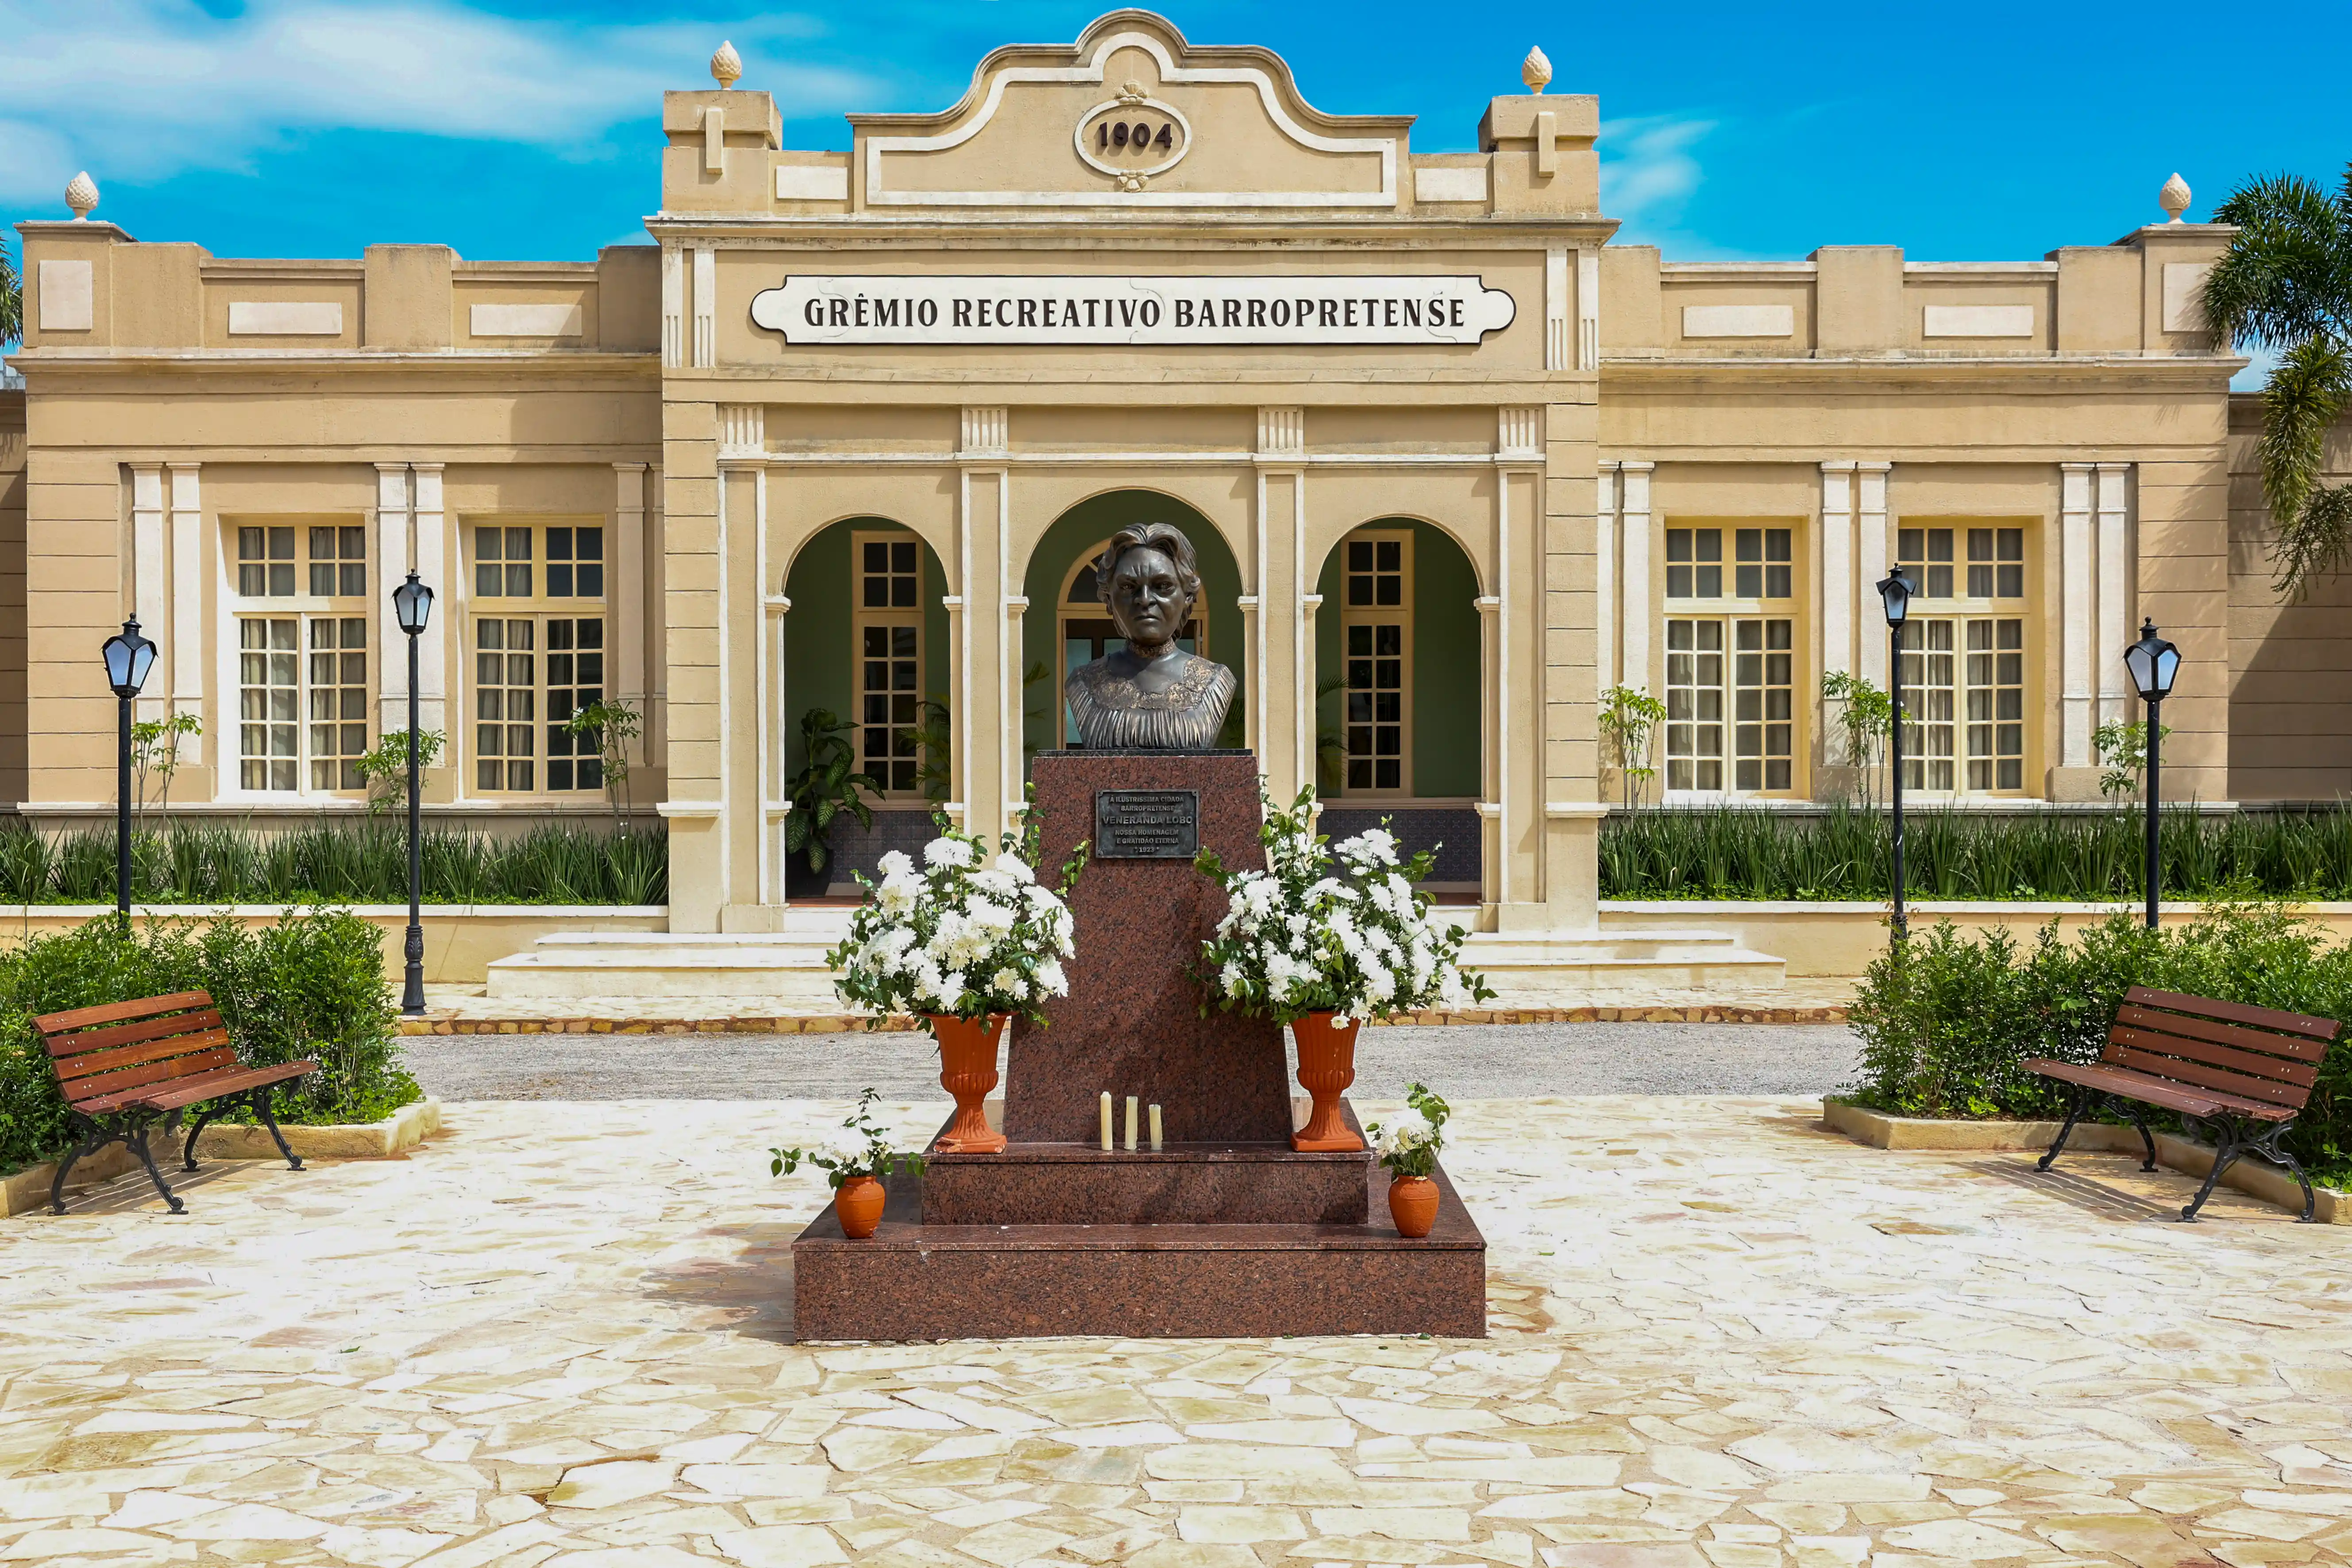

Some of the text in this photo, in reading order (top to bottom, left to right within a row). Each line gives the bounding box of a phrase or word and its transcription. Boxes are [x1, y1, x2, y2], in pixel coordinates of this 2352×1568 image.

[1099, 121, 1173, 149] 1904
[804, 293, 1464, 327] GRÊMIO RECREATIVO BARROPRETENSE
